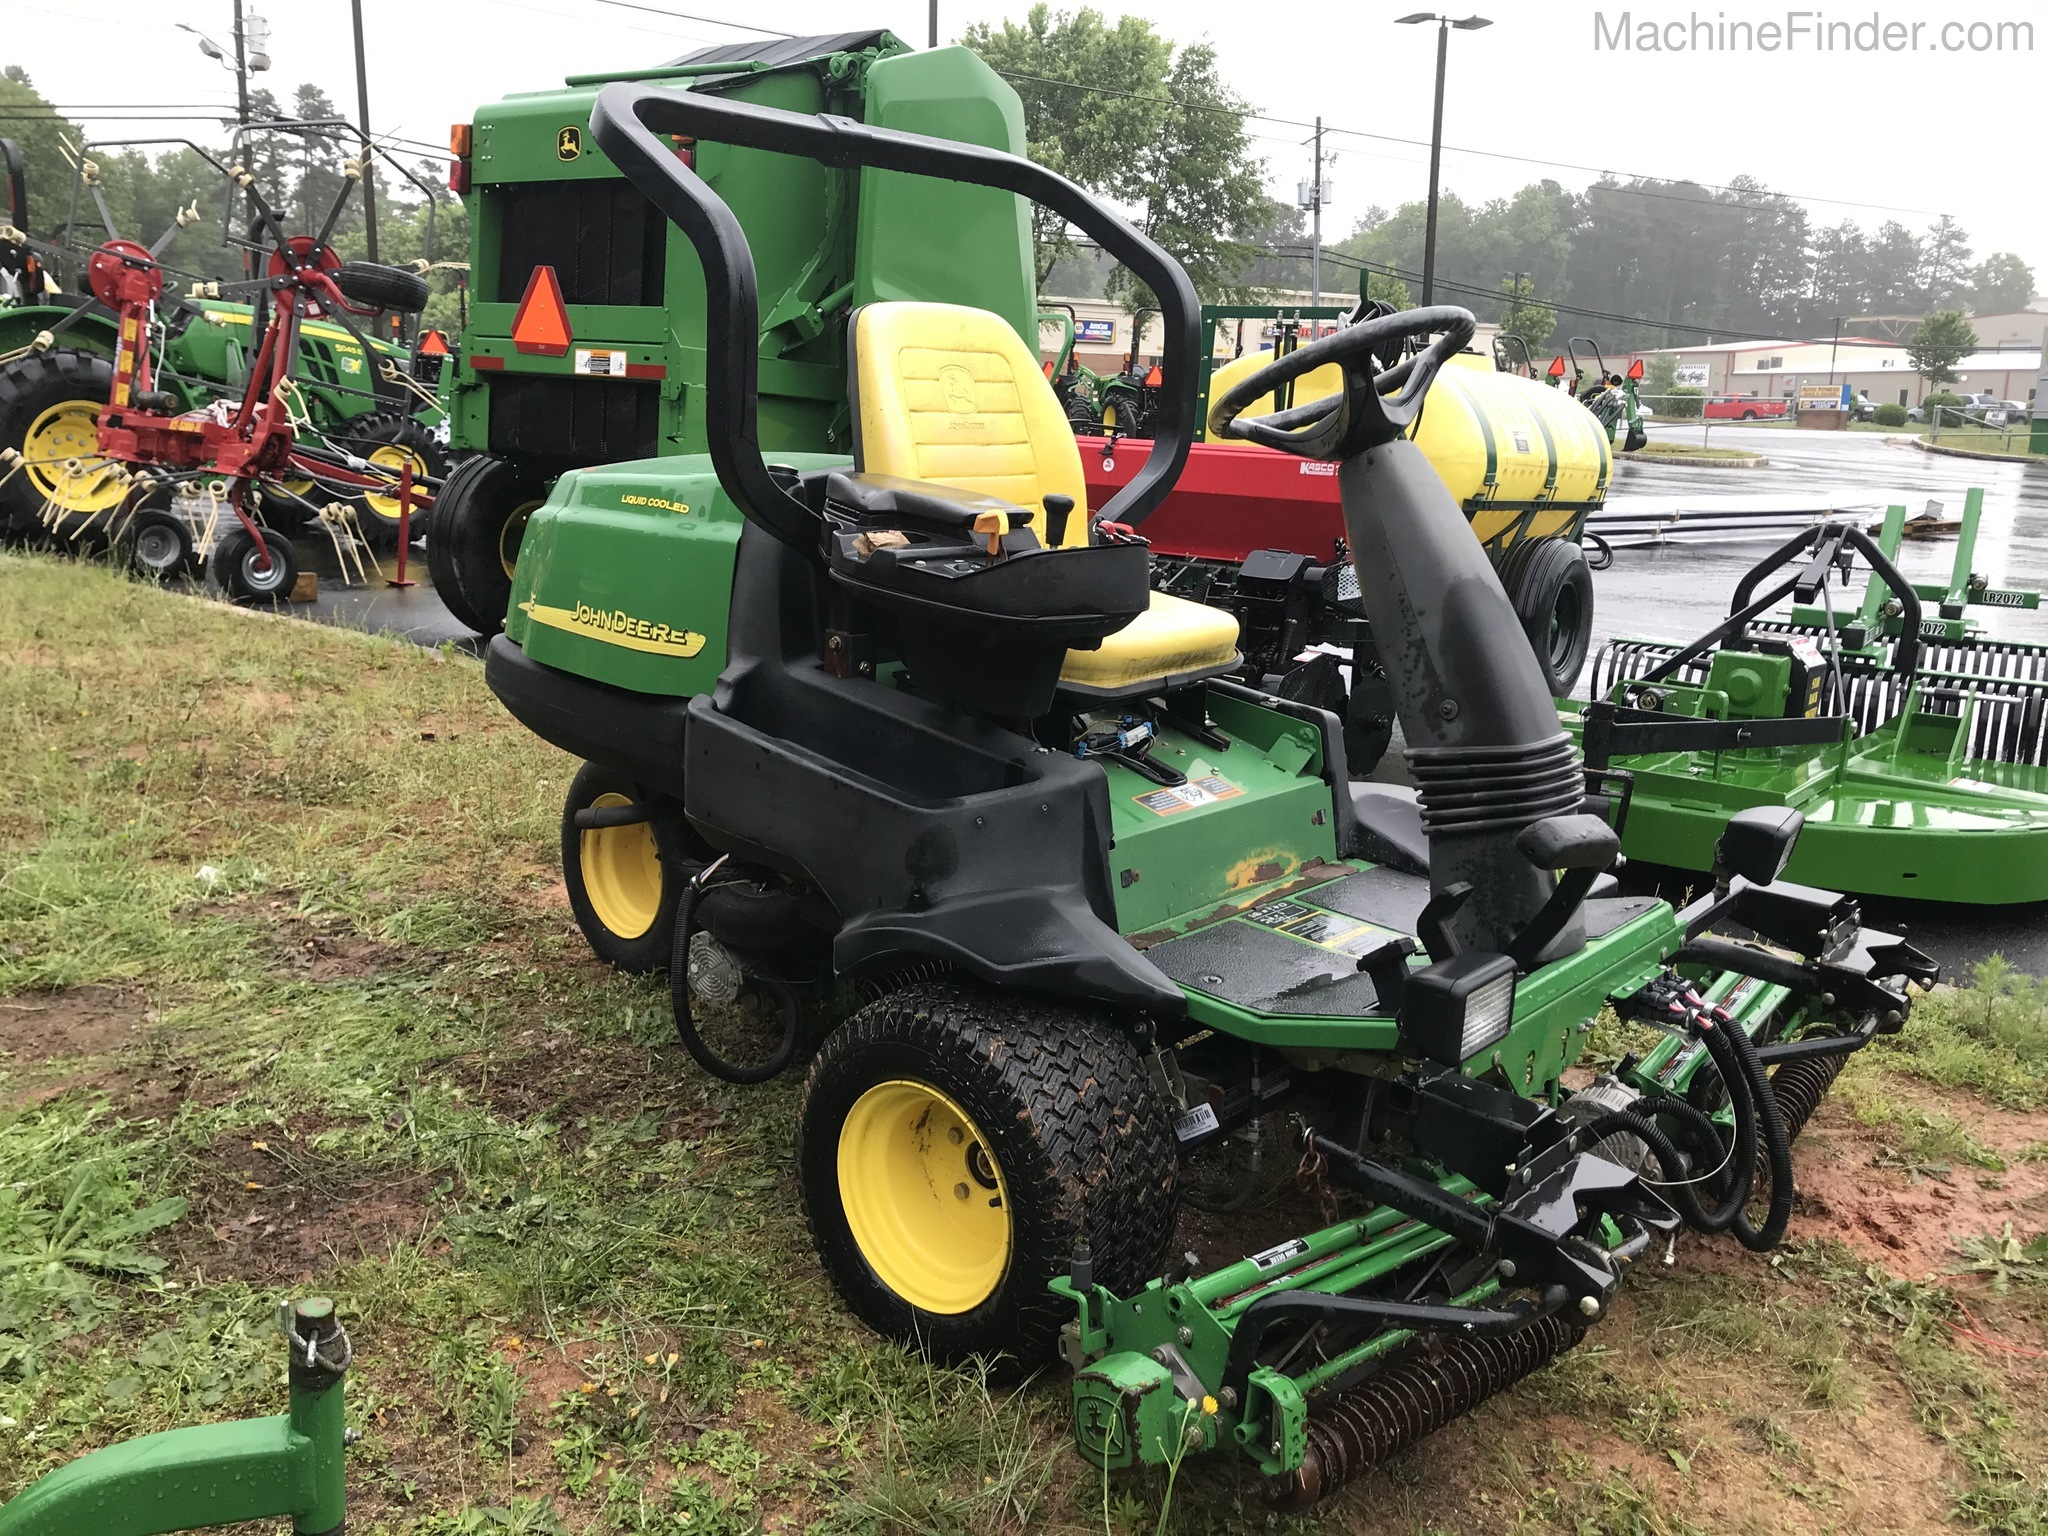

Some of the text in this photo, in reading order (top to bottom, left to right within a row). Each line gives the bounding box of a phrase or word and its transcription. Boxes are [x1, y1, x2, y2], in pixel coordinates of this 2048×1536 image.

[1300, 461, 1335, 475] KASCO
[621, 494, 690, 514] LIQUID COOLED
[1983, 591, 2024, 606] LR2072
[571, 600, 688, 647] JOHN DEERE
[1919, 621, 1946, 636] 2072
